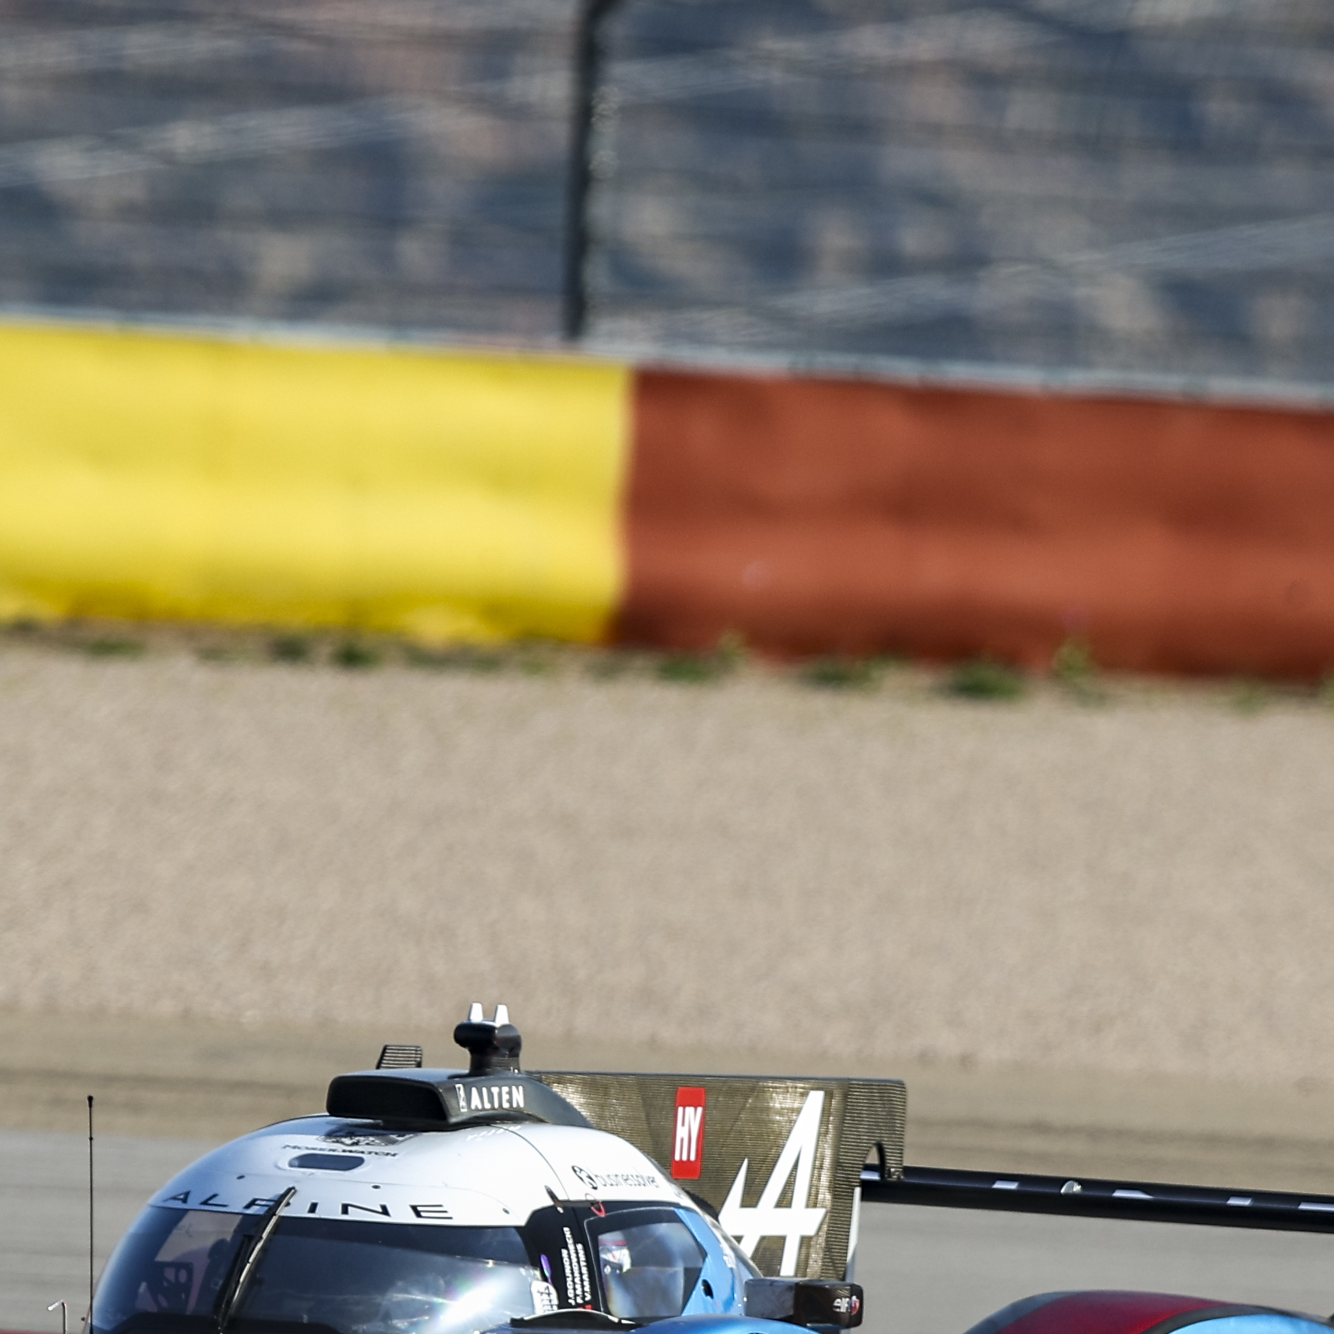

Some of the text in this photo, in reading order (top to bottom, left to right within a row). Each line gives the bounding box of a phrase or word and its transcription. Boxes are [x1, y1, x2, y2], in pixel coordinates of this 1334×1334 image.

[470, 1085, 525, 1110] ALTEN
[675, 1106, 703, 1162] HY
[162, 1190, 454, 1221] ALPINE
[576, 1242, 592, 1301] V.MARTINS
